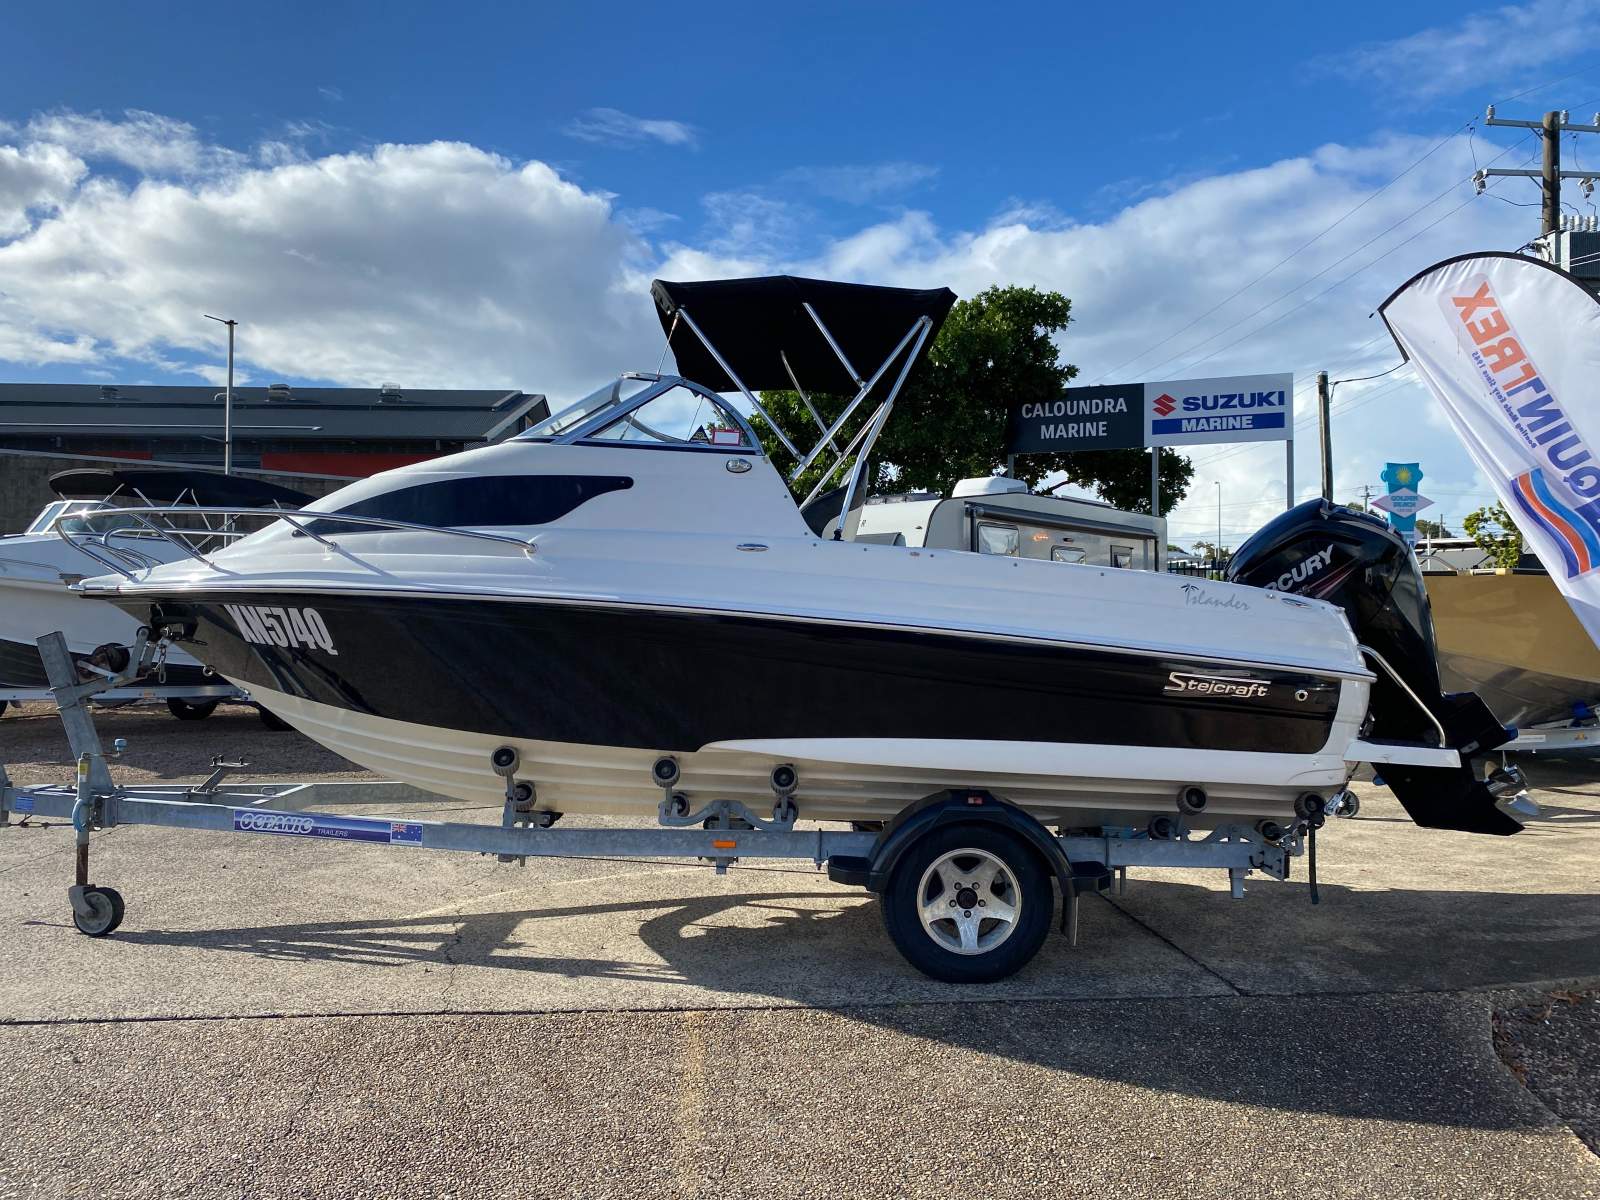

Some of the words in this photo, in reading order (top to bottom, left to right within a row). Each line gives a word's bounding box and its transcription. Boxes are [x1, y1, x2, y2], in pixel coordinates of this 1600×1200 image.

[1021, 397, 1128, 419] CALOUNDRA
[1183, 390, 1285, 412] SUZUKI
[1040, 421, 1108, 440] MARINE
[1181, 415, 1254, 433] MARINE
[223, 604, 339, 656] XN574Q
[1164, 671, 1272, 698] Stejcraft
[240, 812, 315, 834] OCEANIC
[316, 828, 349, 838] TRAILERS
